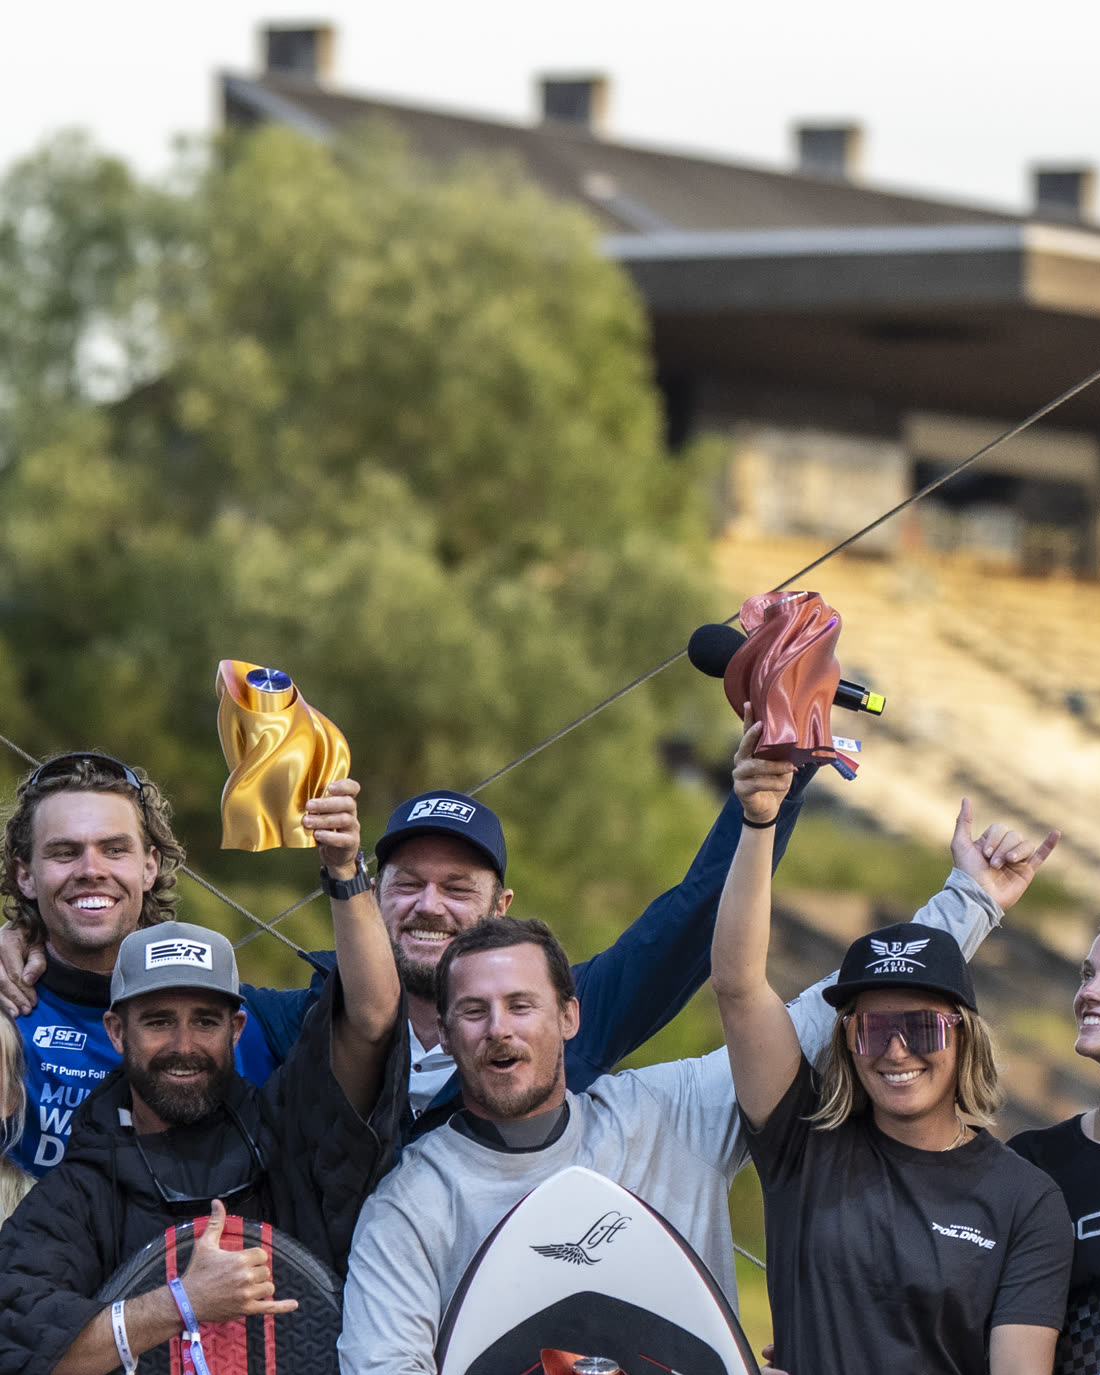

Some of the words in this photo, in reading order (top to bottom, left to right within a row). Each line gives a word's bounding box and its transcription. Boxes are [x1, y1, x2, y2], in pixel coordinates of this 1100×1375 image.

[436, 801, 472, 815] SFT
[891, 942, 902, 952] E
[874, 966, 914, 974] MAROC
[54, 1030, 83, 1042] SFT
[41, 1062, 58, 1074] SFT
[59, 1064, 87, 1078] Pump
[88, 1069, 106, 1080] Foil
[40, 1082, 91, 1108] MU
[39, 1106, 73, 1136] W
